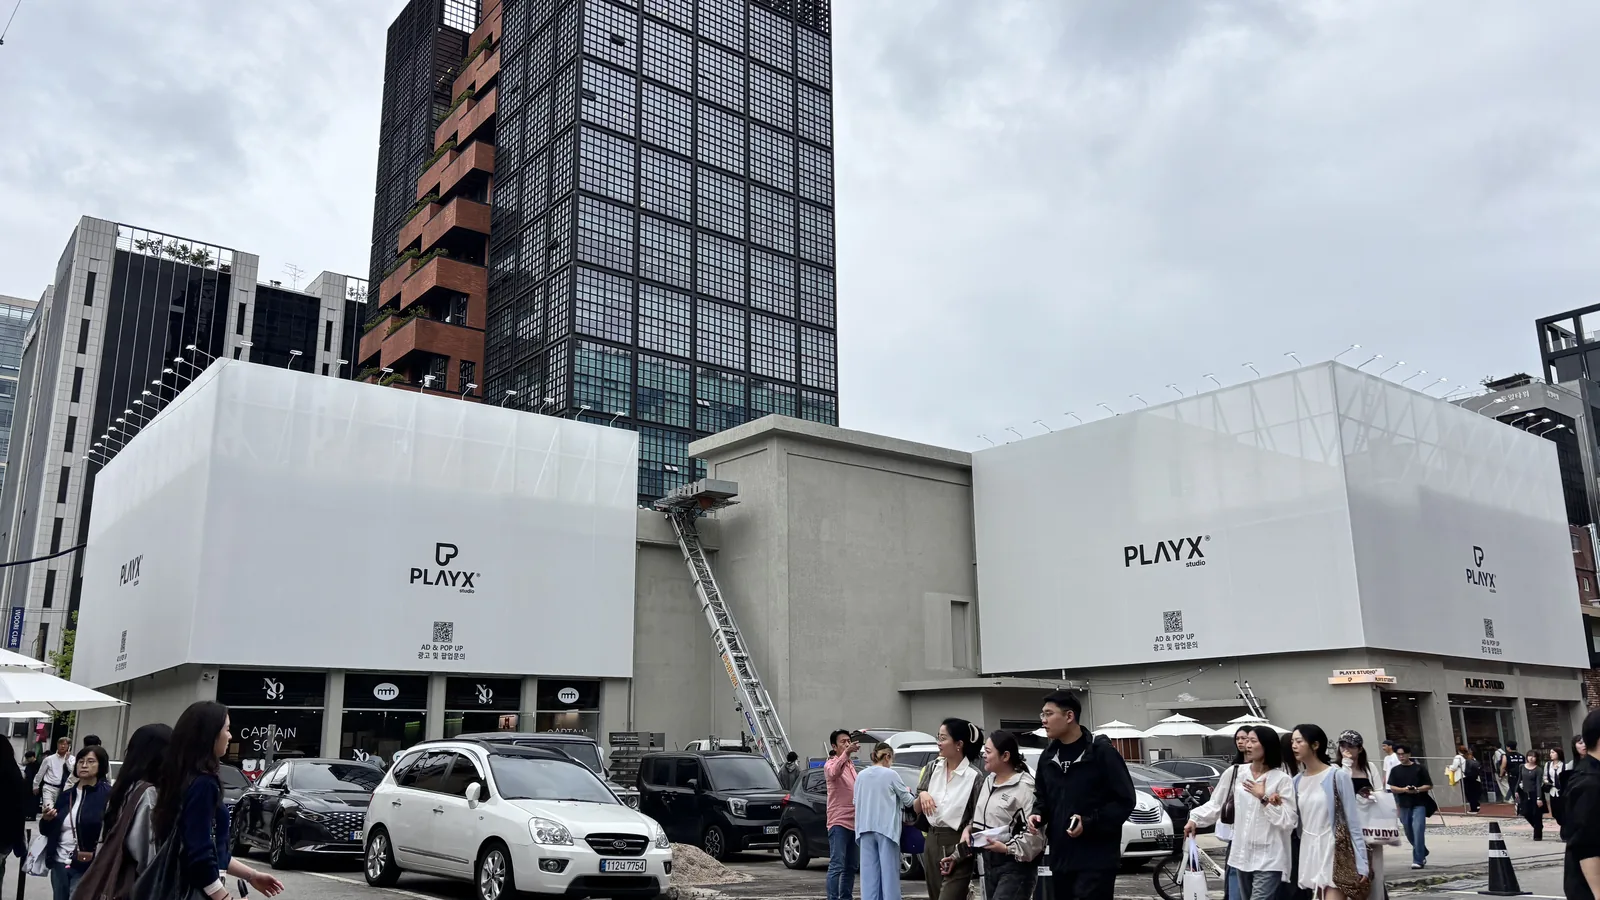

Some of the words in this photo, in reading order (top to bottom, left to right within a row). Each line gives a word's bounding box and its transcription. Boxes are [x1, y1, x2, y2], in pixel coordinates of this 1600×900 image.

[1185, 560, 1206, 568] studio
[13, 609, 21, 630] WOORI
[11, 630, 19, 646] CUBE
[240, 726, 297, 740] CAPAIN
